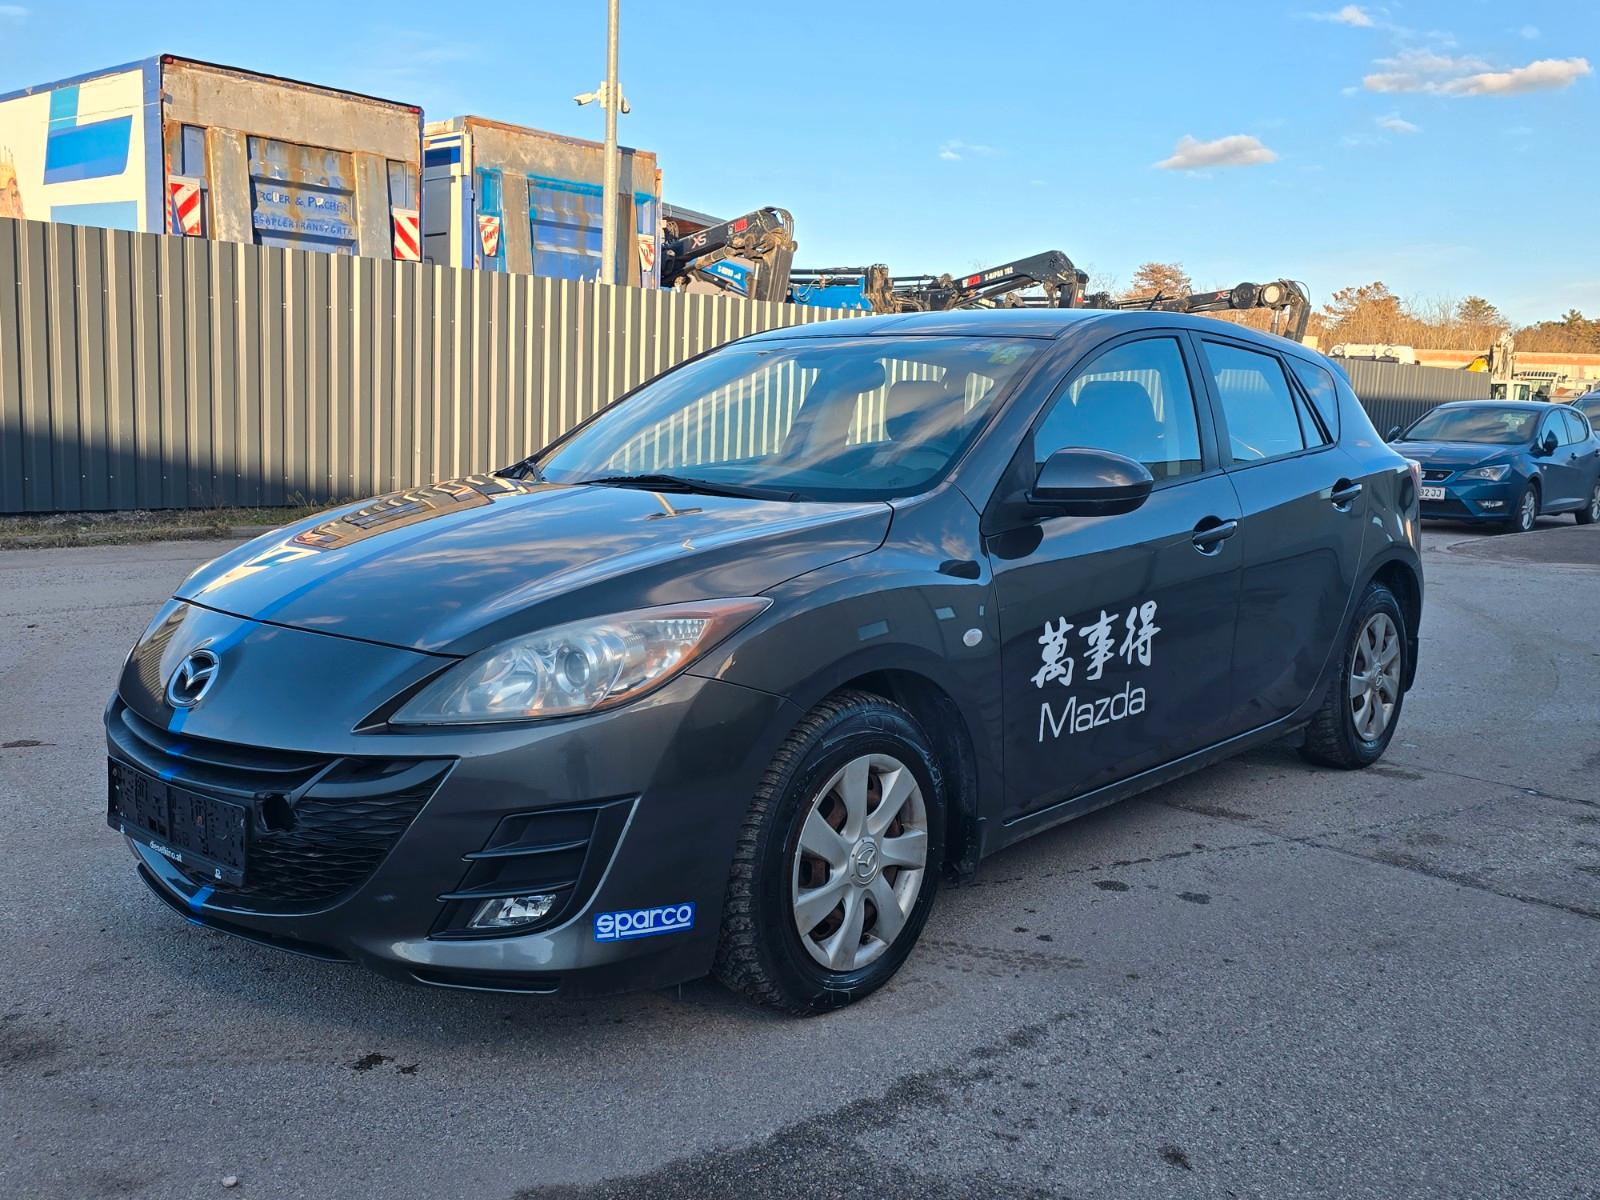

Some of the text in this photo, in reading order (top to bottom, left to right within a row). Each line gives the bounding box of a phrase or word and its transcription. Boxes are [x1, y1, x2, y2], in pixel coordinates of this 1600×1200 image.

[691, 233, 707, 249] XS
[1030, 600, 1161, 688] 萬事得
[1038, 681, 1146, 742] Mazda
[597, 905, 692, 938] sparco
